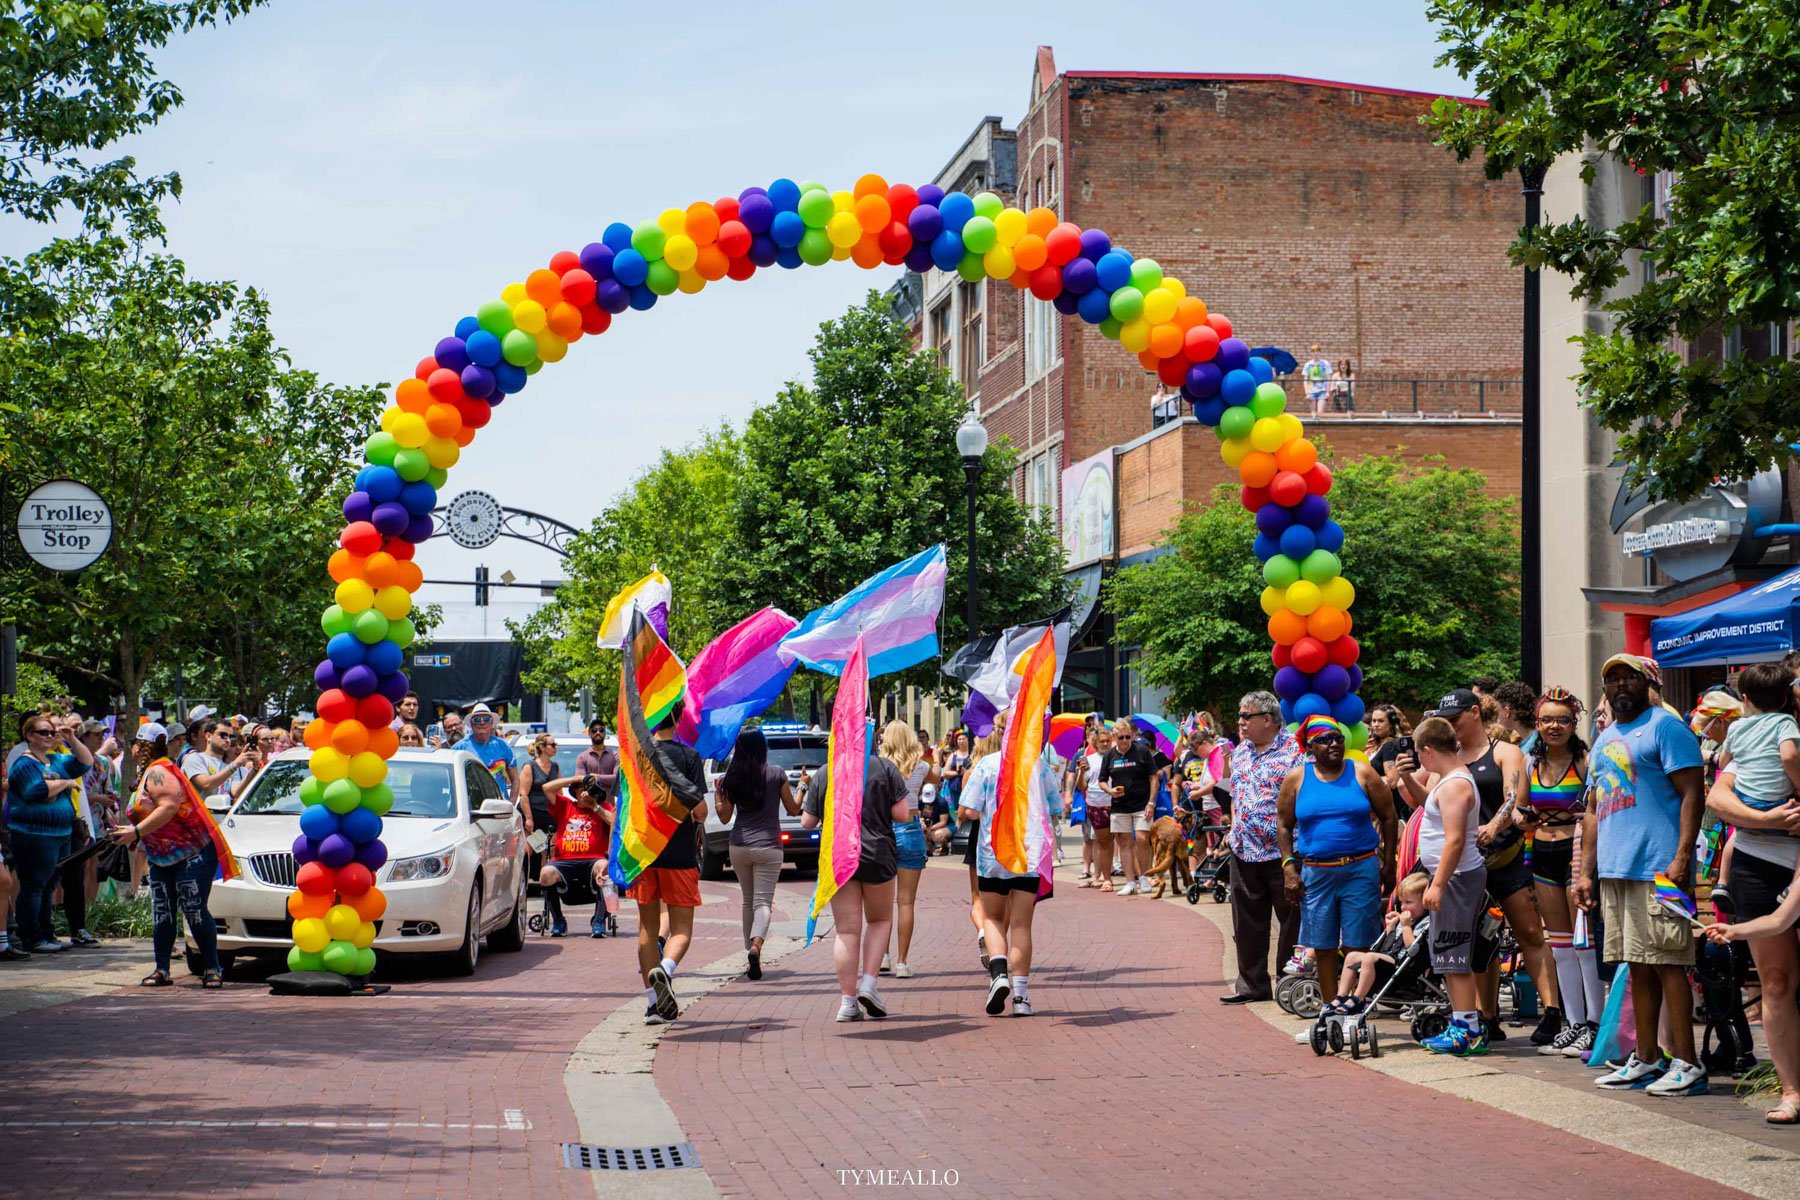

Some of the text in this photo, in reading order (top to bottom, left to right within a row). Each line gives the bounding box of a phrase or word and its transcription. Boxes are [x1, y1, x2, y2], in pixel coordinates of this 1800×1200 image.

[31, 504, 104, 524] Trolley
[454, 500, 494, 518] Evansville
[455, 522, 494, 539] River City
[44, 531, 91, 550] Stop
[1657, 620, 1784, 650] ECONOMIC IMPROVEMENT DISTRICT
[562, 839, 590, 852] PHOTOS
[1434, 930, 1471, 945] JUMP
